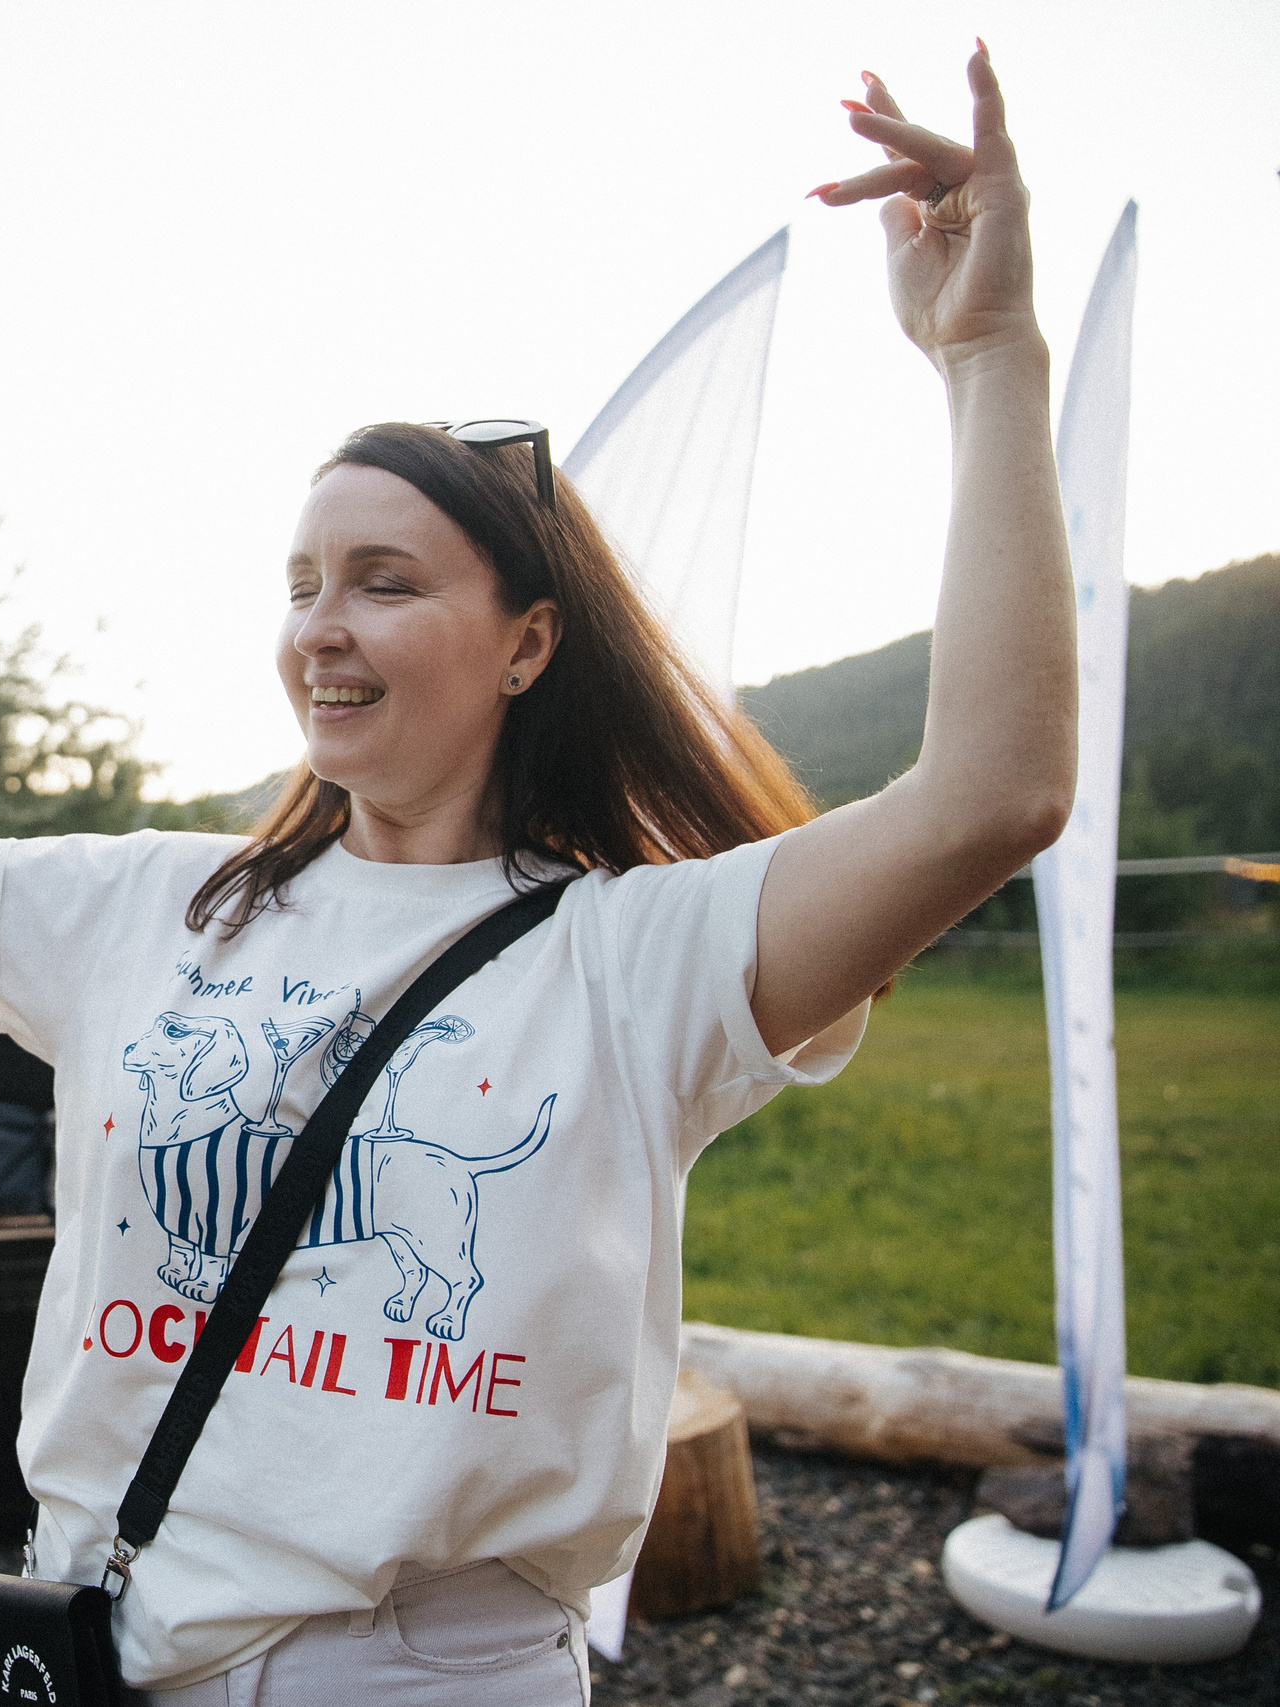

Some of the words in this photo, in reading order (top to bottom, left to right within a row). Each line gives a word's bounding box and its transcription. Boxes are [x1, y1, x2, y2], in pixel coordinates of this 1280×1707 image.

[83, 1299, 357, 1397] OCTAIL
[384, 1337, 527, 1418] TIME
[1, 1653, 15, 1693] KARL
[11, 1644, 57, 1704] LAGERFELD
[20, 1688, 38, 1701] PARIS
